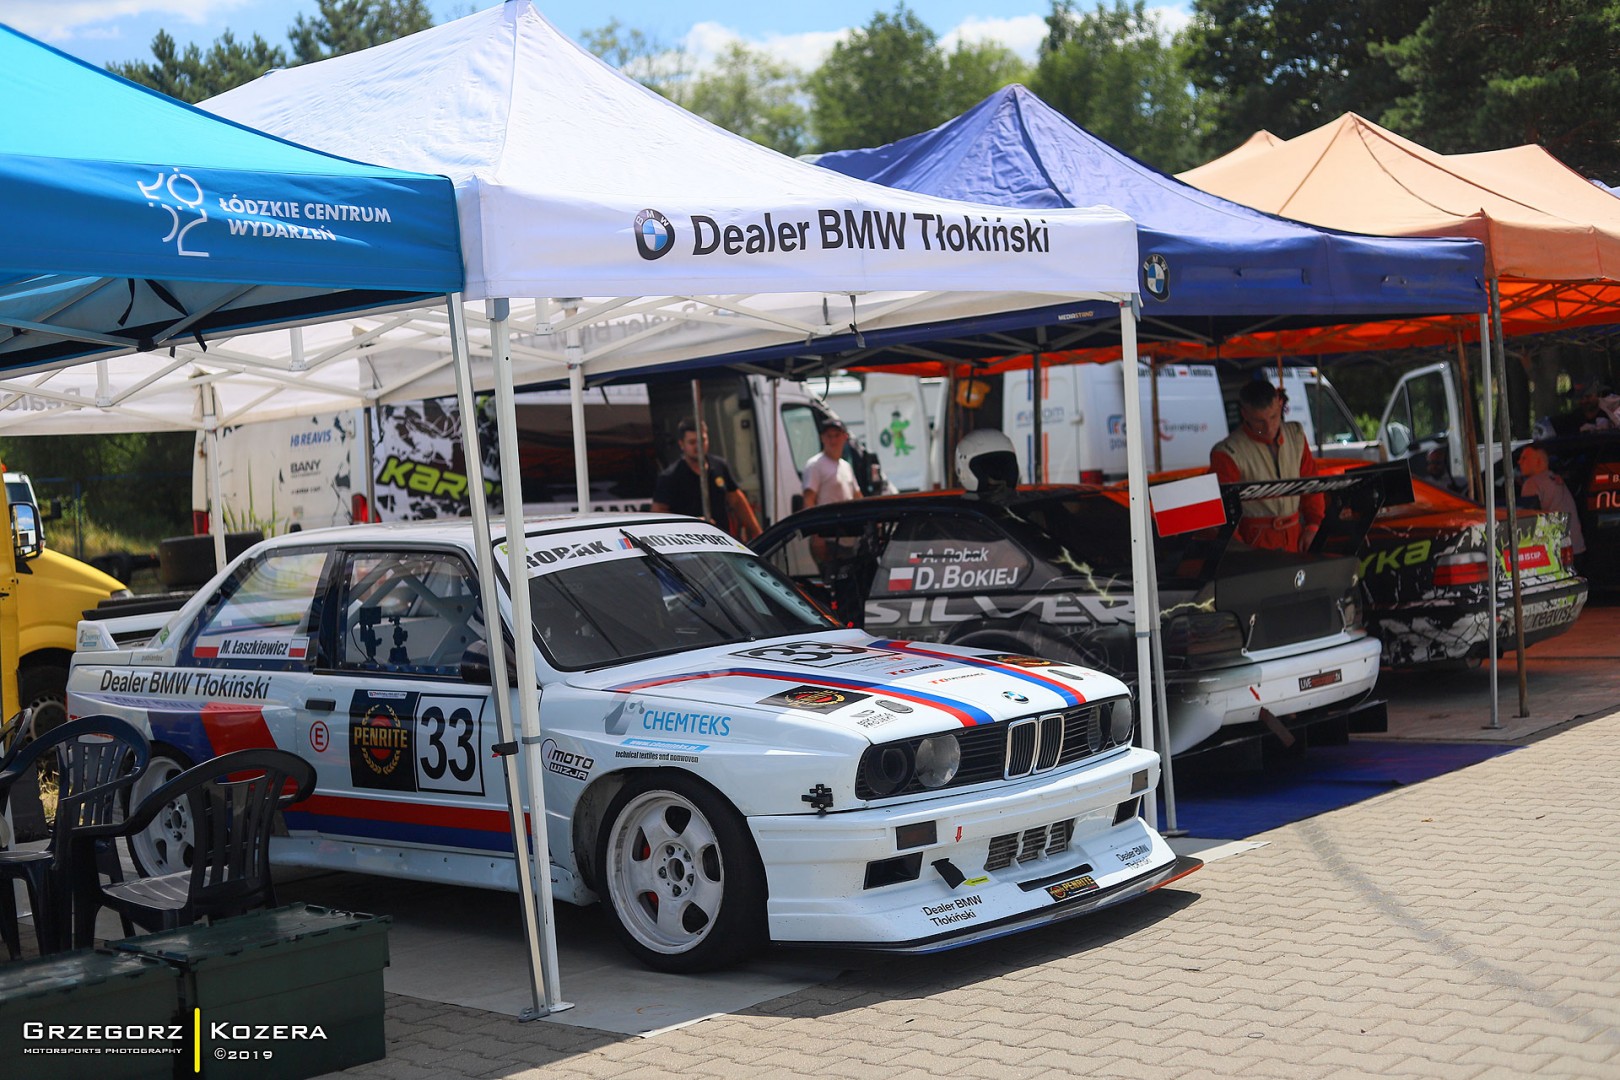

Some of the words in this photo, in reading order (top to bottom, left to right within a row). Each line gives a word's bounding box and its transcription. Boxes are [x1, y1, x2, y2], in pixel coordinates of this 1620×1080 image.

[218, 193, 300, 219] ŁÓDZKIE
[303, 202, 392, 223] CENTRUM
[227, 219, 337, 241] WYDARZEŃ
[690, 212, 810, 256] Dealer
[817, 209, 907, 250] BMW
[912, 212, 1050, 253] Tłokiński
[290, 460, 321, 474] BANY
[638, 533, 734, 547] MOTORSPORT
[220, 639, 231, 654] M.
[231, 638, 289, 656] Łaszkiewicz
[100, 670, 148, 693] Dealer
[149, 671, 193, 695] BMW
[194, 673, 272, 700] Tłokiński
[643, 710, 732, 736] CHEMTEKS
[314, 727, 324, 746] E
[353, 726, 408, 749] PENRITE
[420, 705, 476, 782] 33
[551, 750, 595, 770] MOTO
[614, 750, 639, 760] technical
[639, 751, 659, 761] textiles
[659, 753, 670, 761] and
[550, 763, 589, 781] WIZJA
[1061, 876, 1095, 891] PENRITE
[922, 901, 955, 916] Dealer
[956, 894, 983, 909] BMW
[929, 908, 977, 928] Tłokiński
